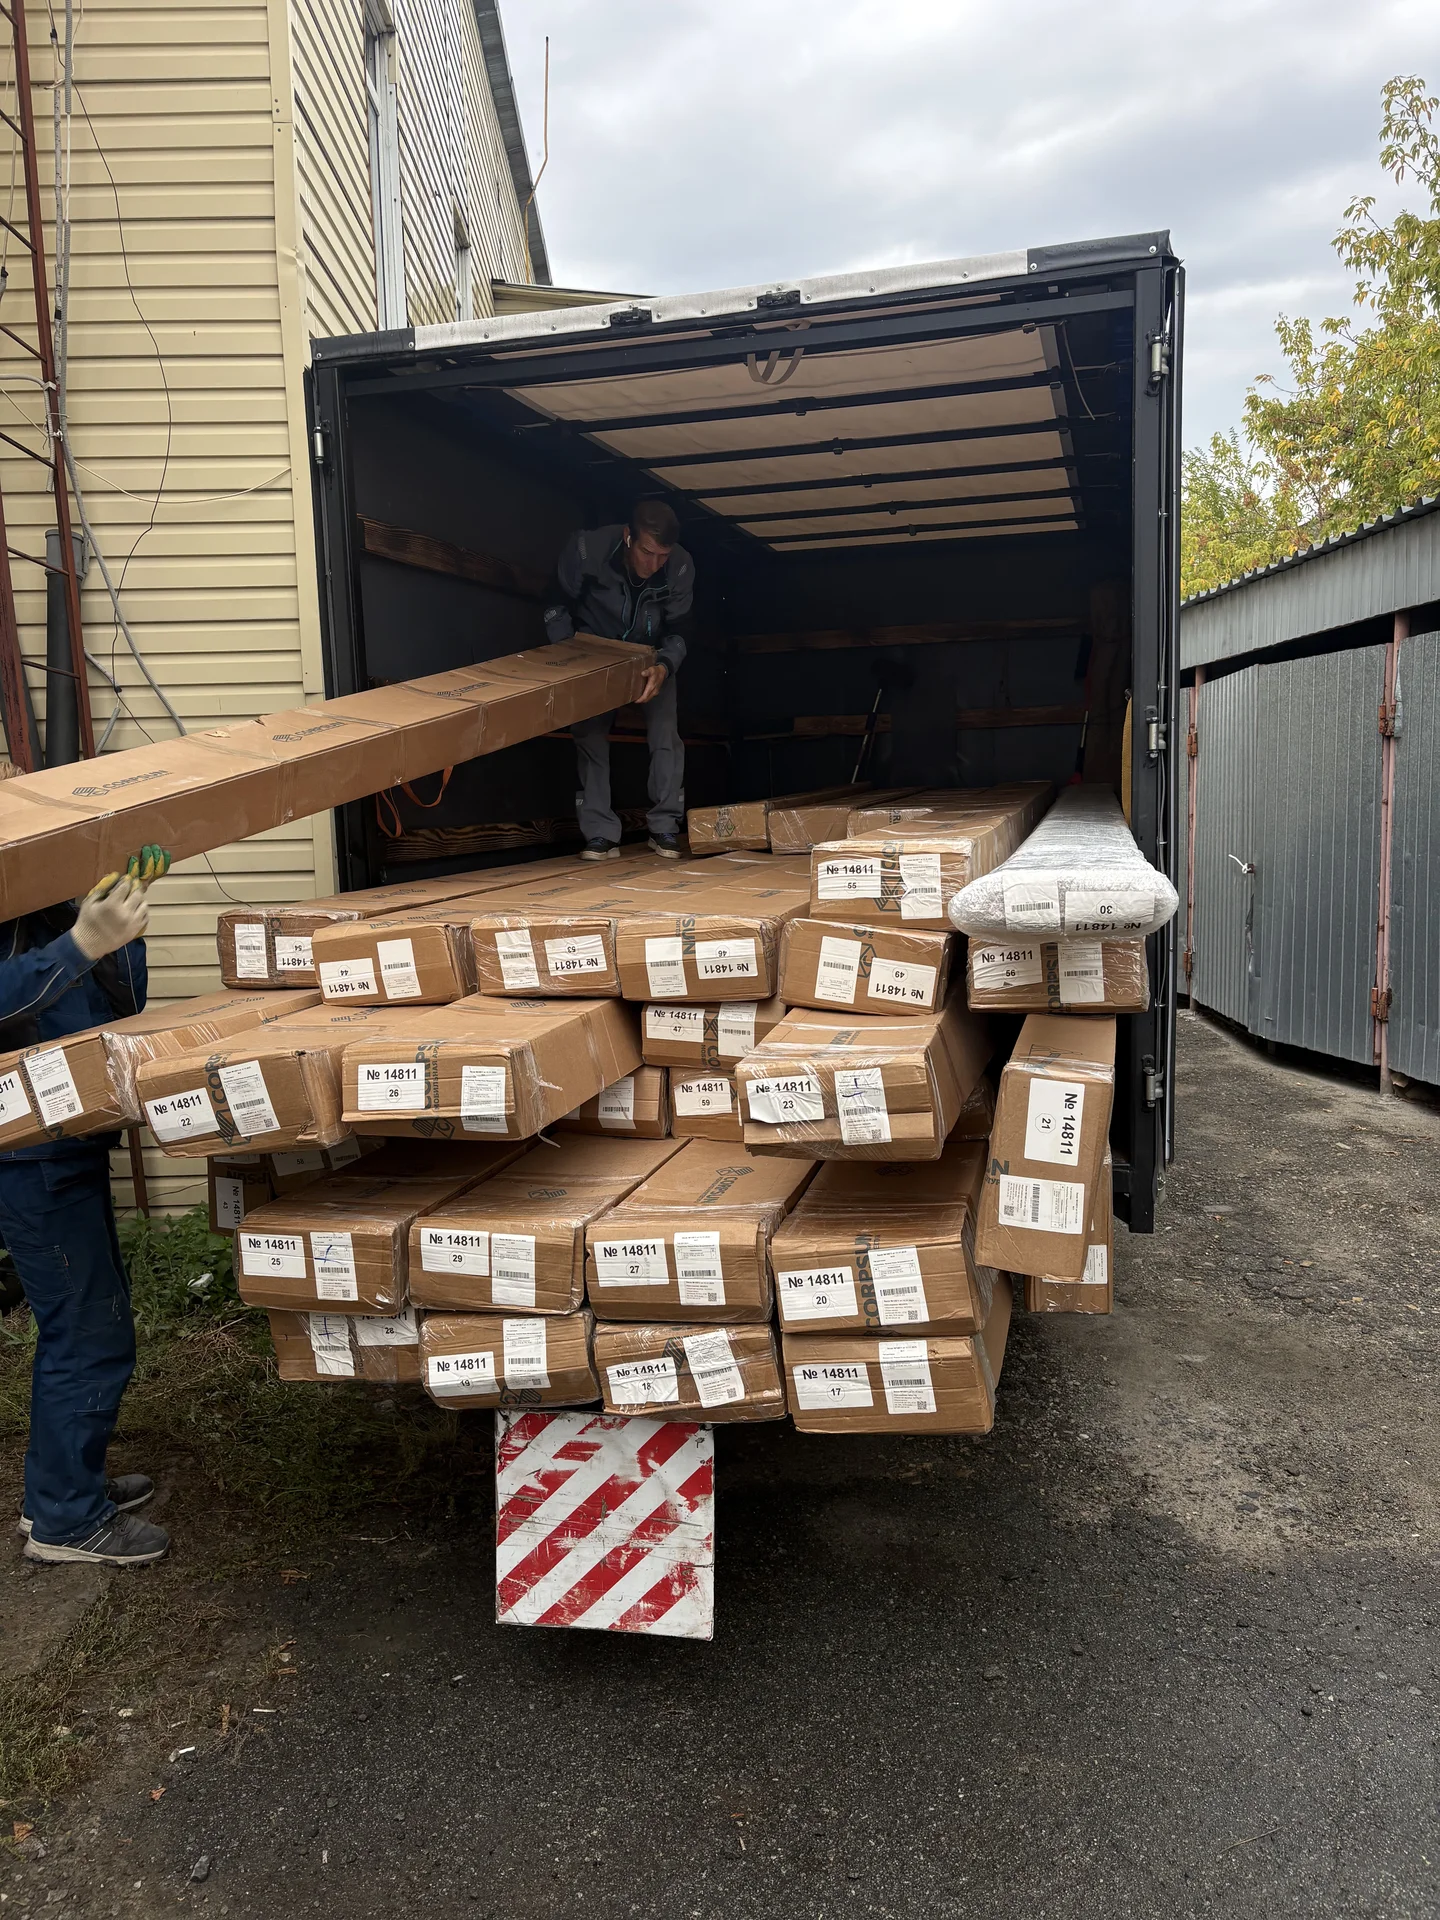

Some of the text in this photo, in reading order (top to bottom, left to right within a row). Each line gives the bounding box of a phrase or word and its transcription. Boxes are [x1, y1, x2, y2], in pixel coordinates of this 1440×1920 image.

[826, 864, 874, 874] № 14811
[1100, 905, 1112, 914] 30
[1075, 922, 1117, 931] 14811
[294, 944, 302, 952] 54
[282, 958, 307, 966] 14811
[982, 950, 1033, 963] № 14811
[555, 957, 598, 970] № 14811
[704, 962, 749, 974] № 14811
[340, 967, 349, 977] 44
[895, 970, 905, 978] 49
[1005, 969, 1016, 977] 56
[329, 981, 369, 994] № 14811
[876, 983, 924, 1000] № 14811
[654, 1010, 698, 1020] № 14811
[366, 1068, 417, 1080] № 14811
[389, 1088, 399, 1098] 26
[681, 1082, 724, 1094] № 14811
[756, 1080, 812, 1094] № 14811
[154, 1094, 202, 1116] № 14811
[783, 1100, 794, 1109] 23
[180, 1118, 191, 1126] 22
[1041, 1118, 1051, 1130] 21
[1060, 1092, 1078, 1156] № 14811
[233, 1200, 241, 1224] 14811
[248, 1238, 296, 1250] № 14811
[429, 1234, 481, 1247] № 14811
[603, 1244, 657, 1258] № 14811
[271, 1257, 281, 1266] 25
[452, 1254, 463, 1263] 29
[629, 1265, 640, 1274] 27
[788, 1272, 845, 1289] № 14811
[816, 1295, 828, 1306] 20
[436, 1358, 487, 1372] № 14811
[633, 1363, 668, 1375] 14811
[802, 1367, 859, 1380] № 14811
[641, 1382, 652, 1391] 18
[831, 1387, 841, 1397] 17
